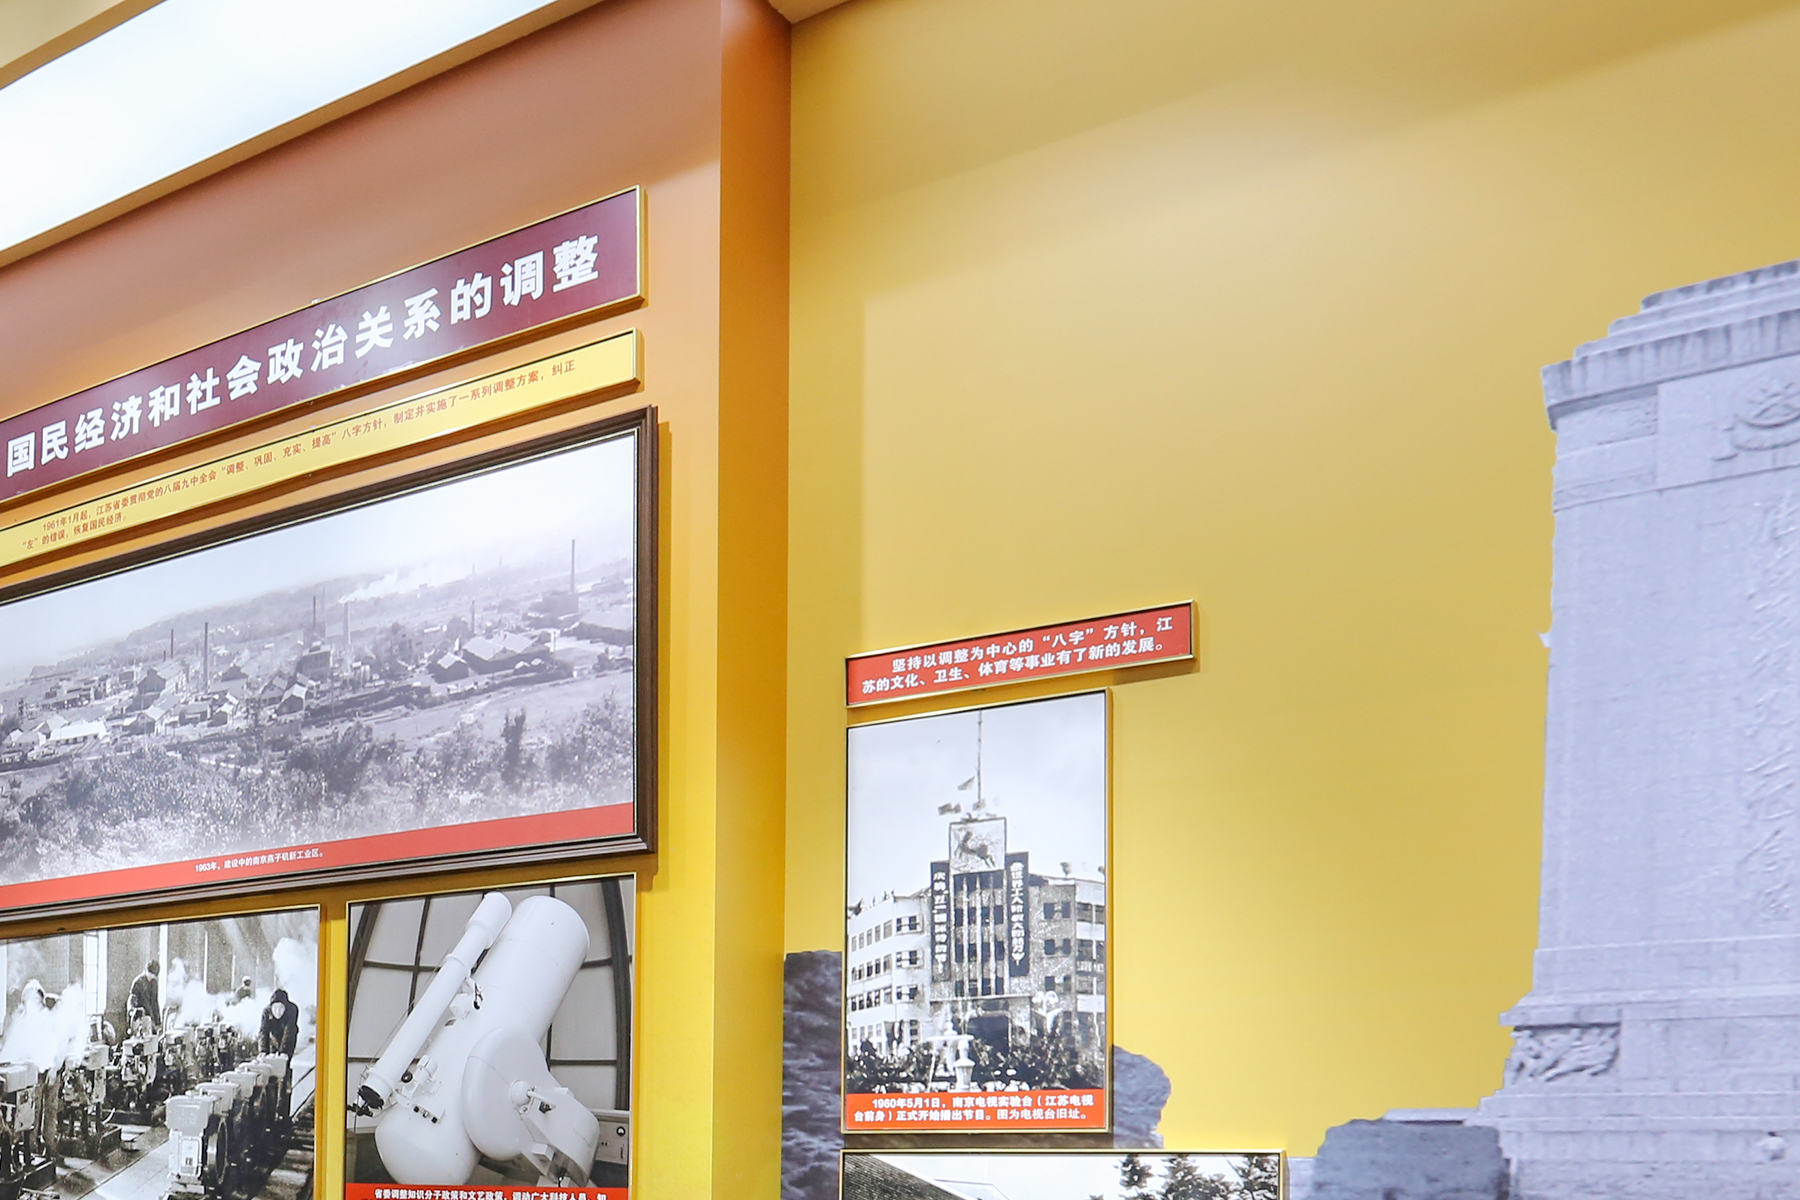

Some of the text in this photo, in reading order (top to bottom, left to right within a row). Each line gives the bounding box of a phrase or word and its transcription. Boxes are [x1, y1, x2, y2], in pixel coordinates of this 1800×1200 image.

[6, 235, 598, 478] 国民经济和社会政治关系的调整
[862, 637, 1164, 694] 苏的文化、卫生、体育等事业有了新的发展。
[892, 617, 1173, 672] 坚持以调整为中心的“八字”方针，江
